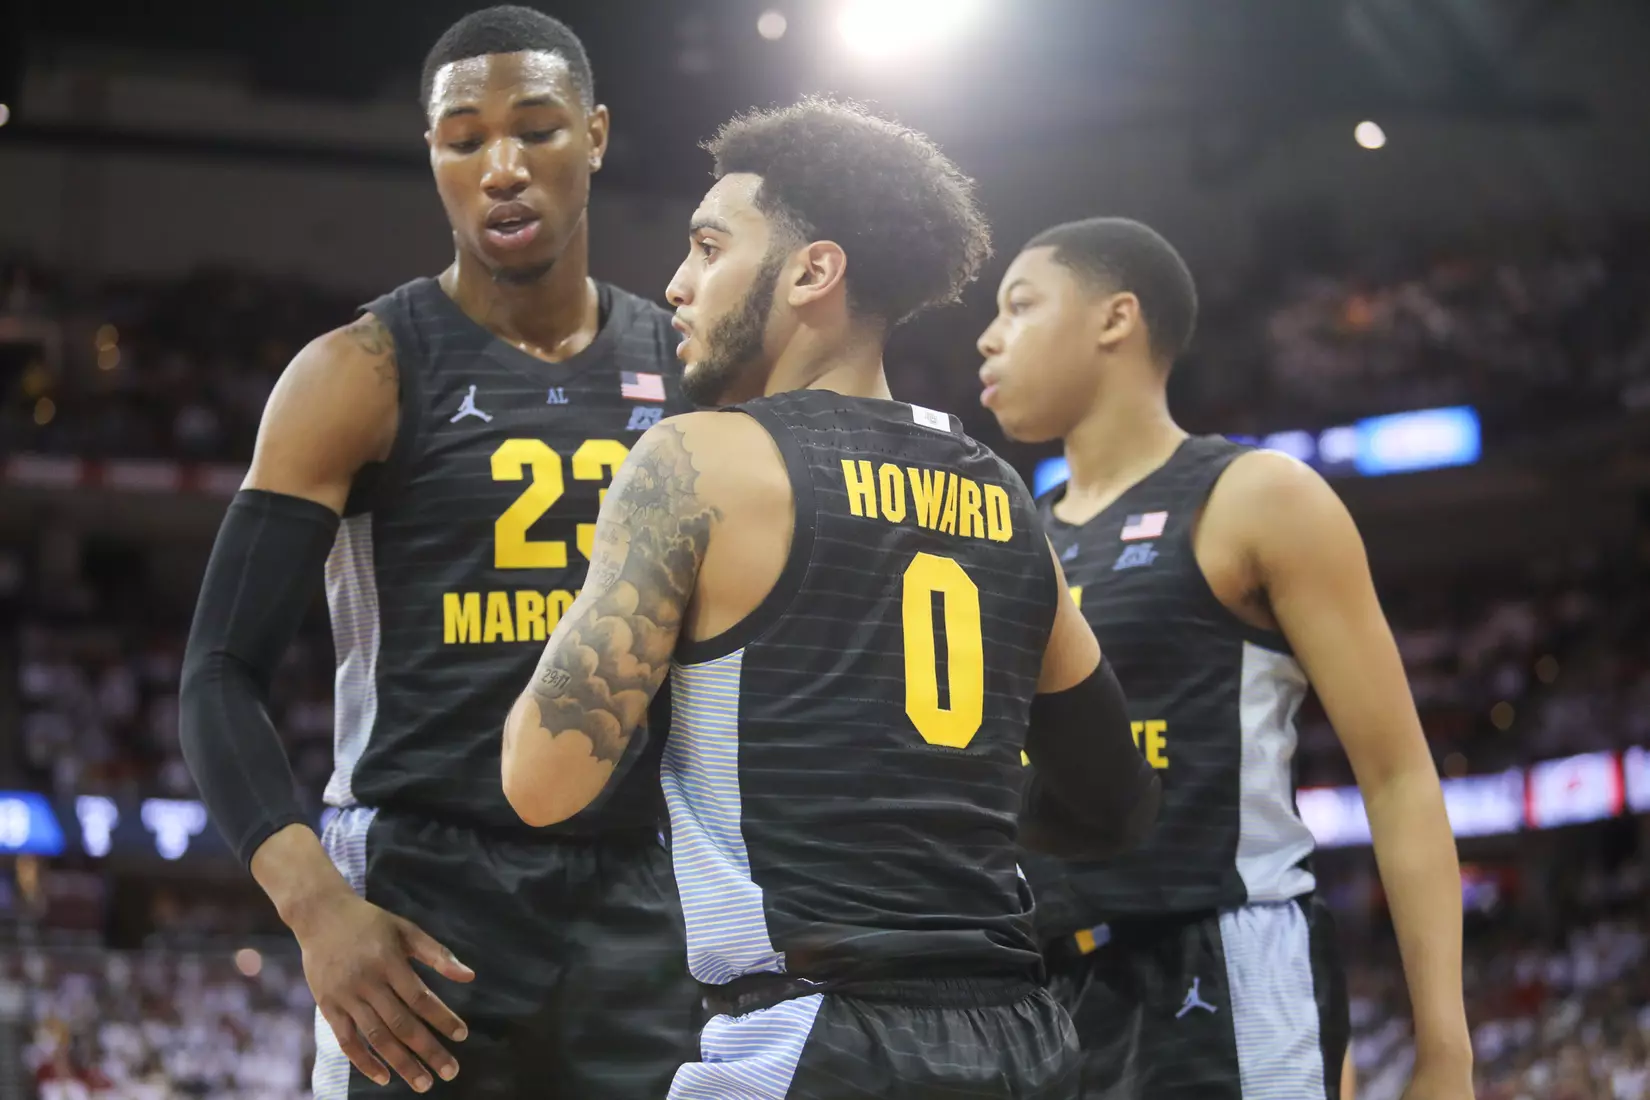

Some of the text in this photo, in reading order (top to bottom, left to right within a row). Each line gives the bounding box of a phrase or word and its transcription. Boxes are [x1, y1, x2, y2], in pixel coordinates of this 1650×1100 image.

[490, 438, 630, 569] 23
[840, 459, 1013, 542] HOWARD
[443, 589, 582, 644] MARQ
[902, 551, 984, 749] 0
